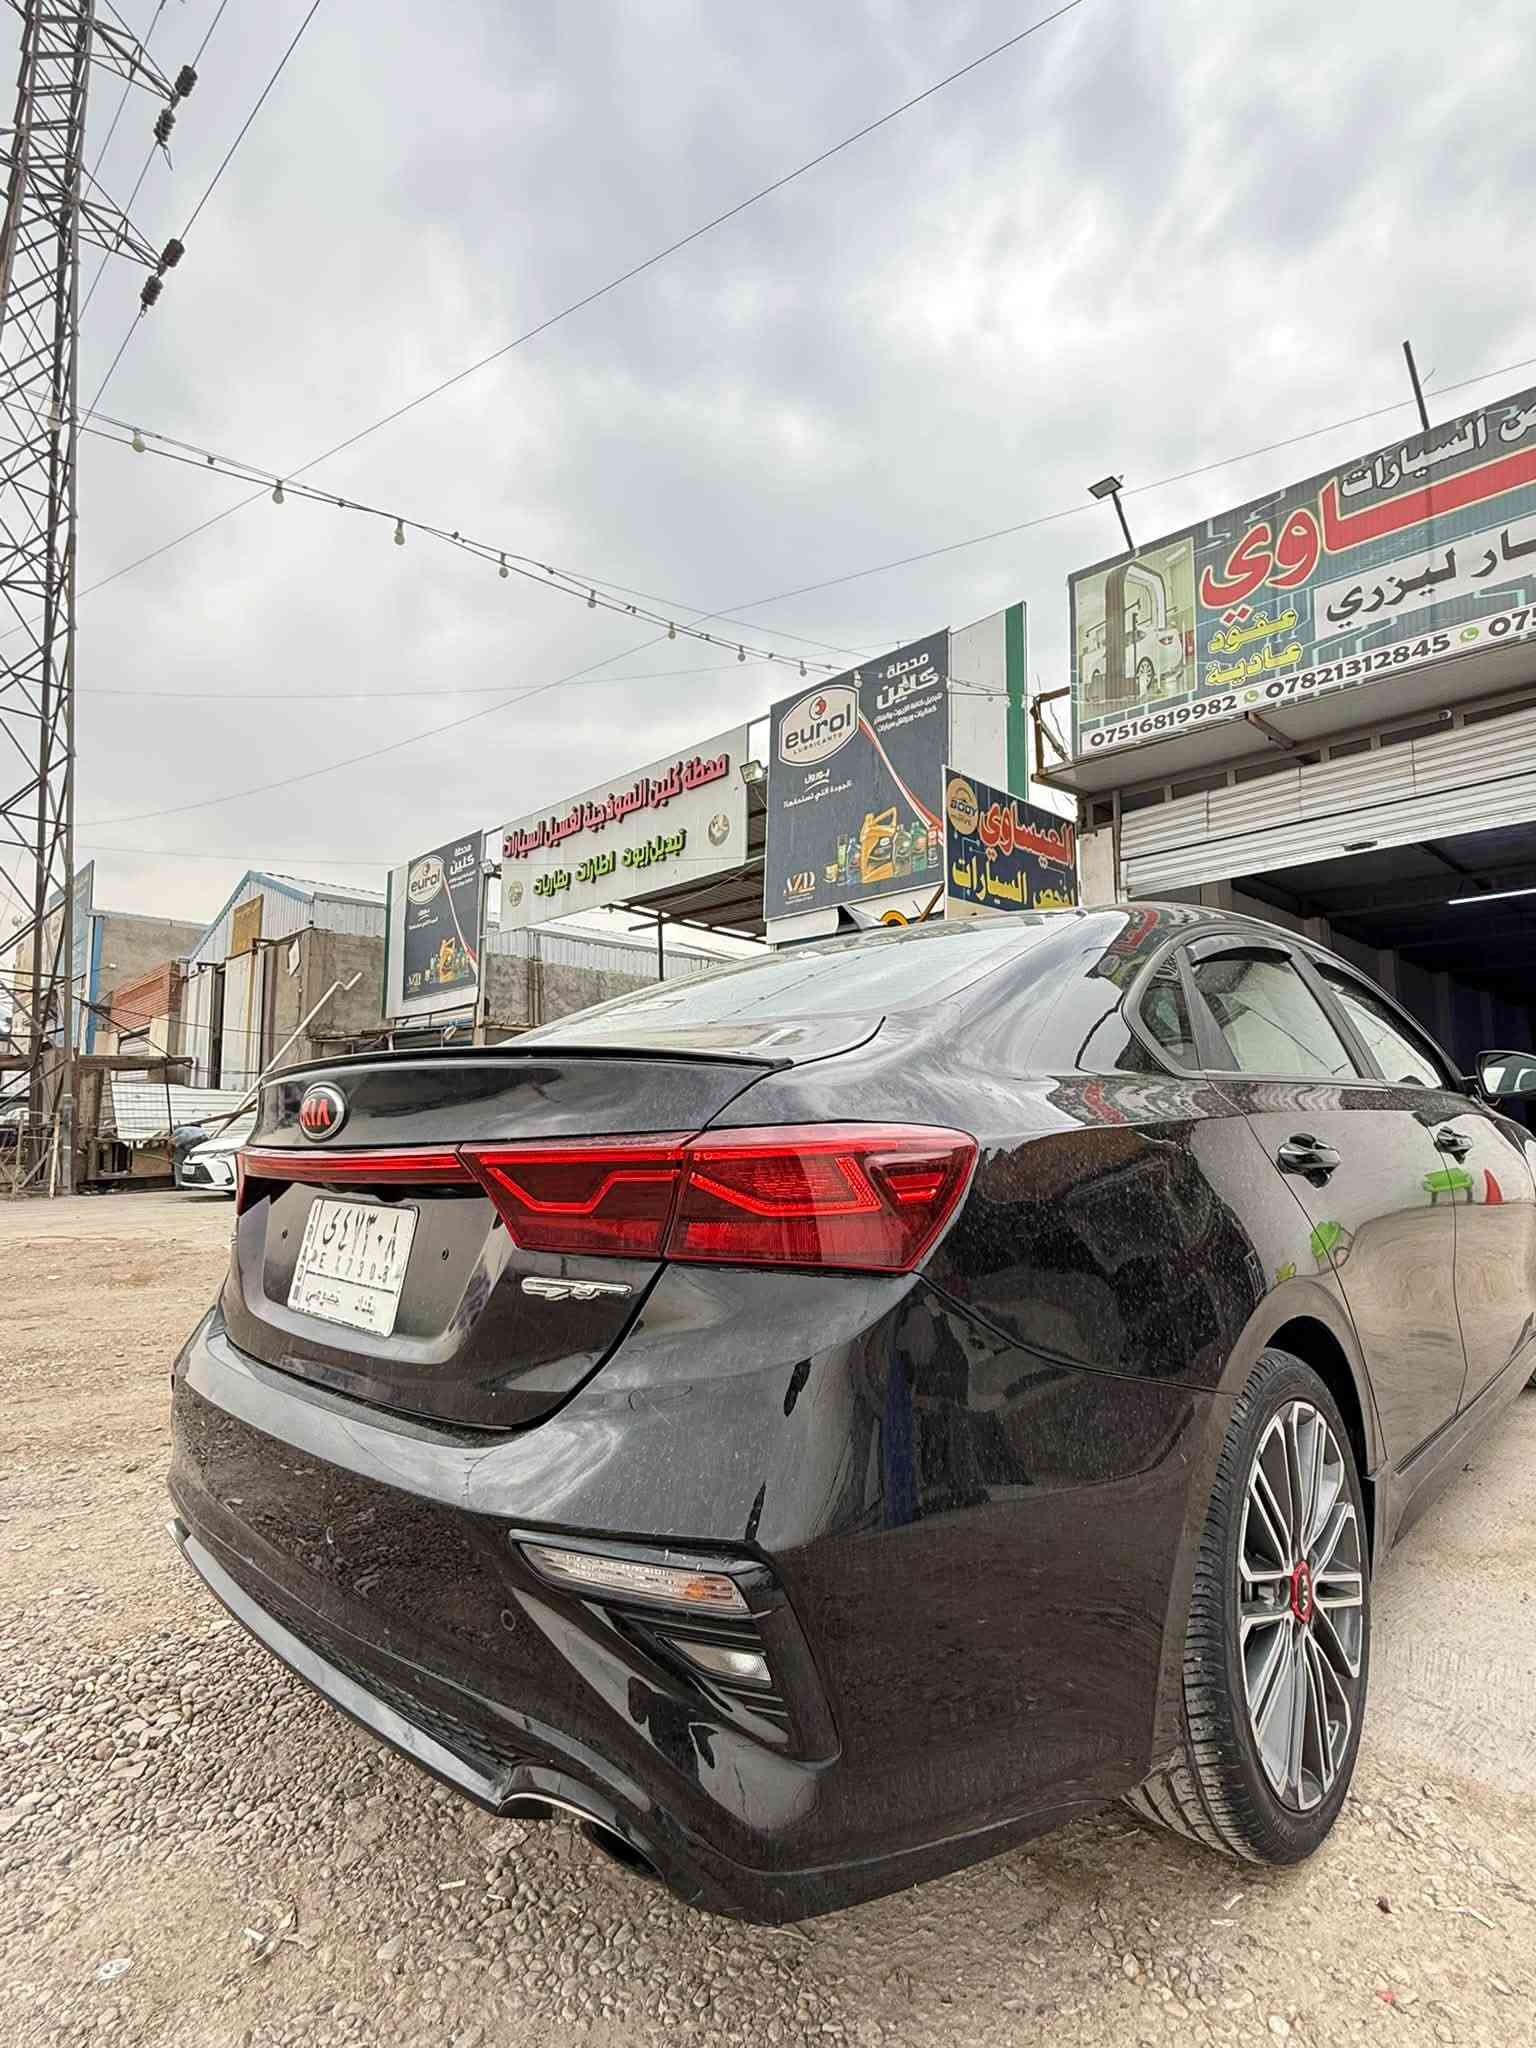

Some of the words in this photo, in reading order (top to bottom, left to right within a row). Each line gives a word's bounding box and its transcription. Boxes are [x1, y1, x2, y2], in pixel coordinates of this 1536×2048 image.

[1342, 413, 1487, 497] السيارات
[1326, 546, 1456, 628] ليزري
[887, 653, 929, 679] محطة
[1205, 641, 1303, 686] عادية
[1090, 695, 1238, 747] 07516819982
[1265, 633, 1451, 699] 07821312845
[785, 704, 851, 750] eurol
[651, 761, 683, 809] كلين
[682, 753, 730, 790] محطة
[543, 803, 585, 849] لغسيل
[584, 777, 650, 833] النموذجية
[503, 820, 547, 859] السيارات
[621, 840, 651, 868] زيوت
[649, 828, 687, 862] تبديل
[410, 868, 441, 893] eurol
[534, 869, 571, 897] بطاريات
[576, 851, 616, 884] اطارات
[952, 855, 1028, 905] السيارات
[303, 1098, 331, 1126] KIA
